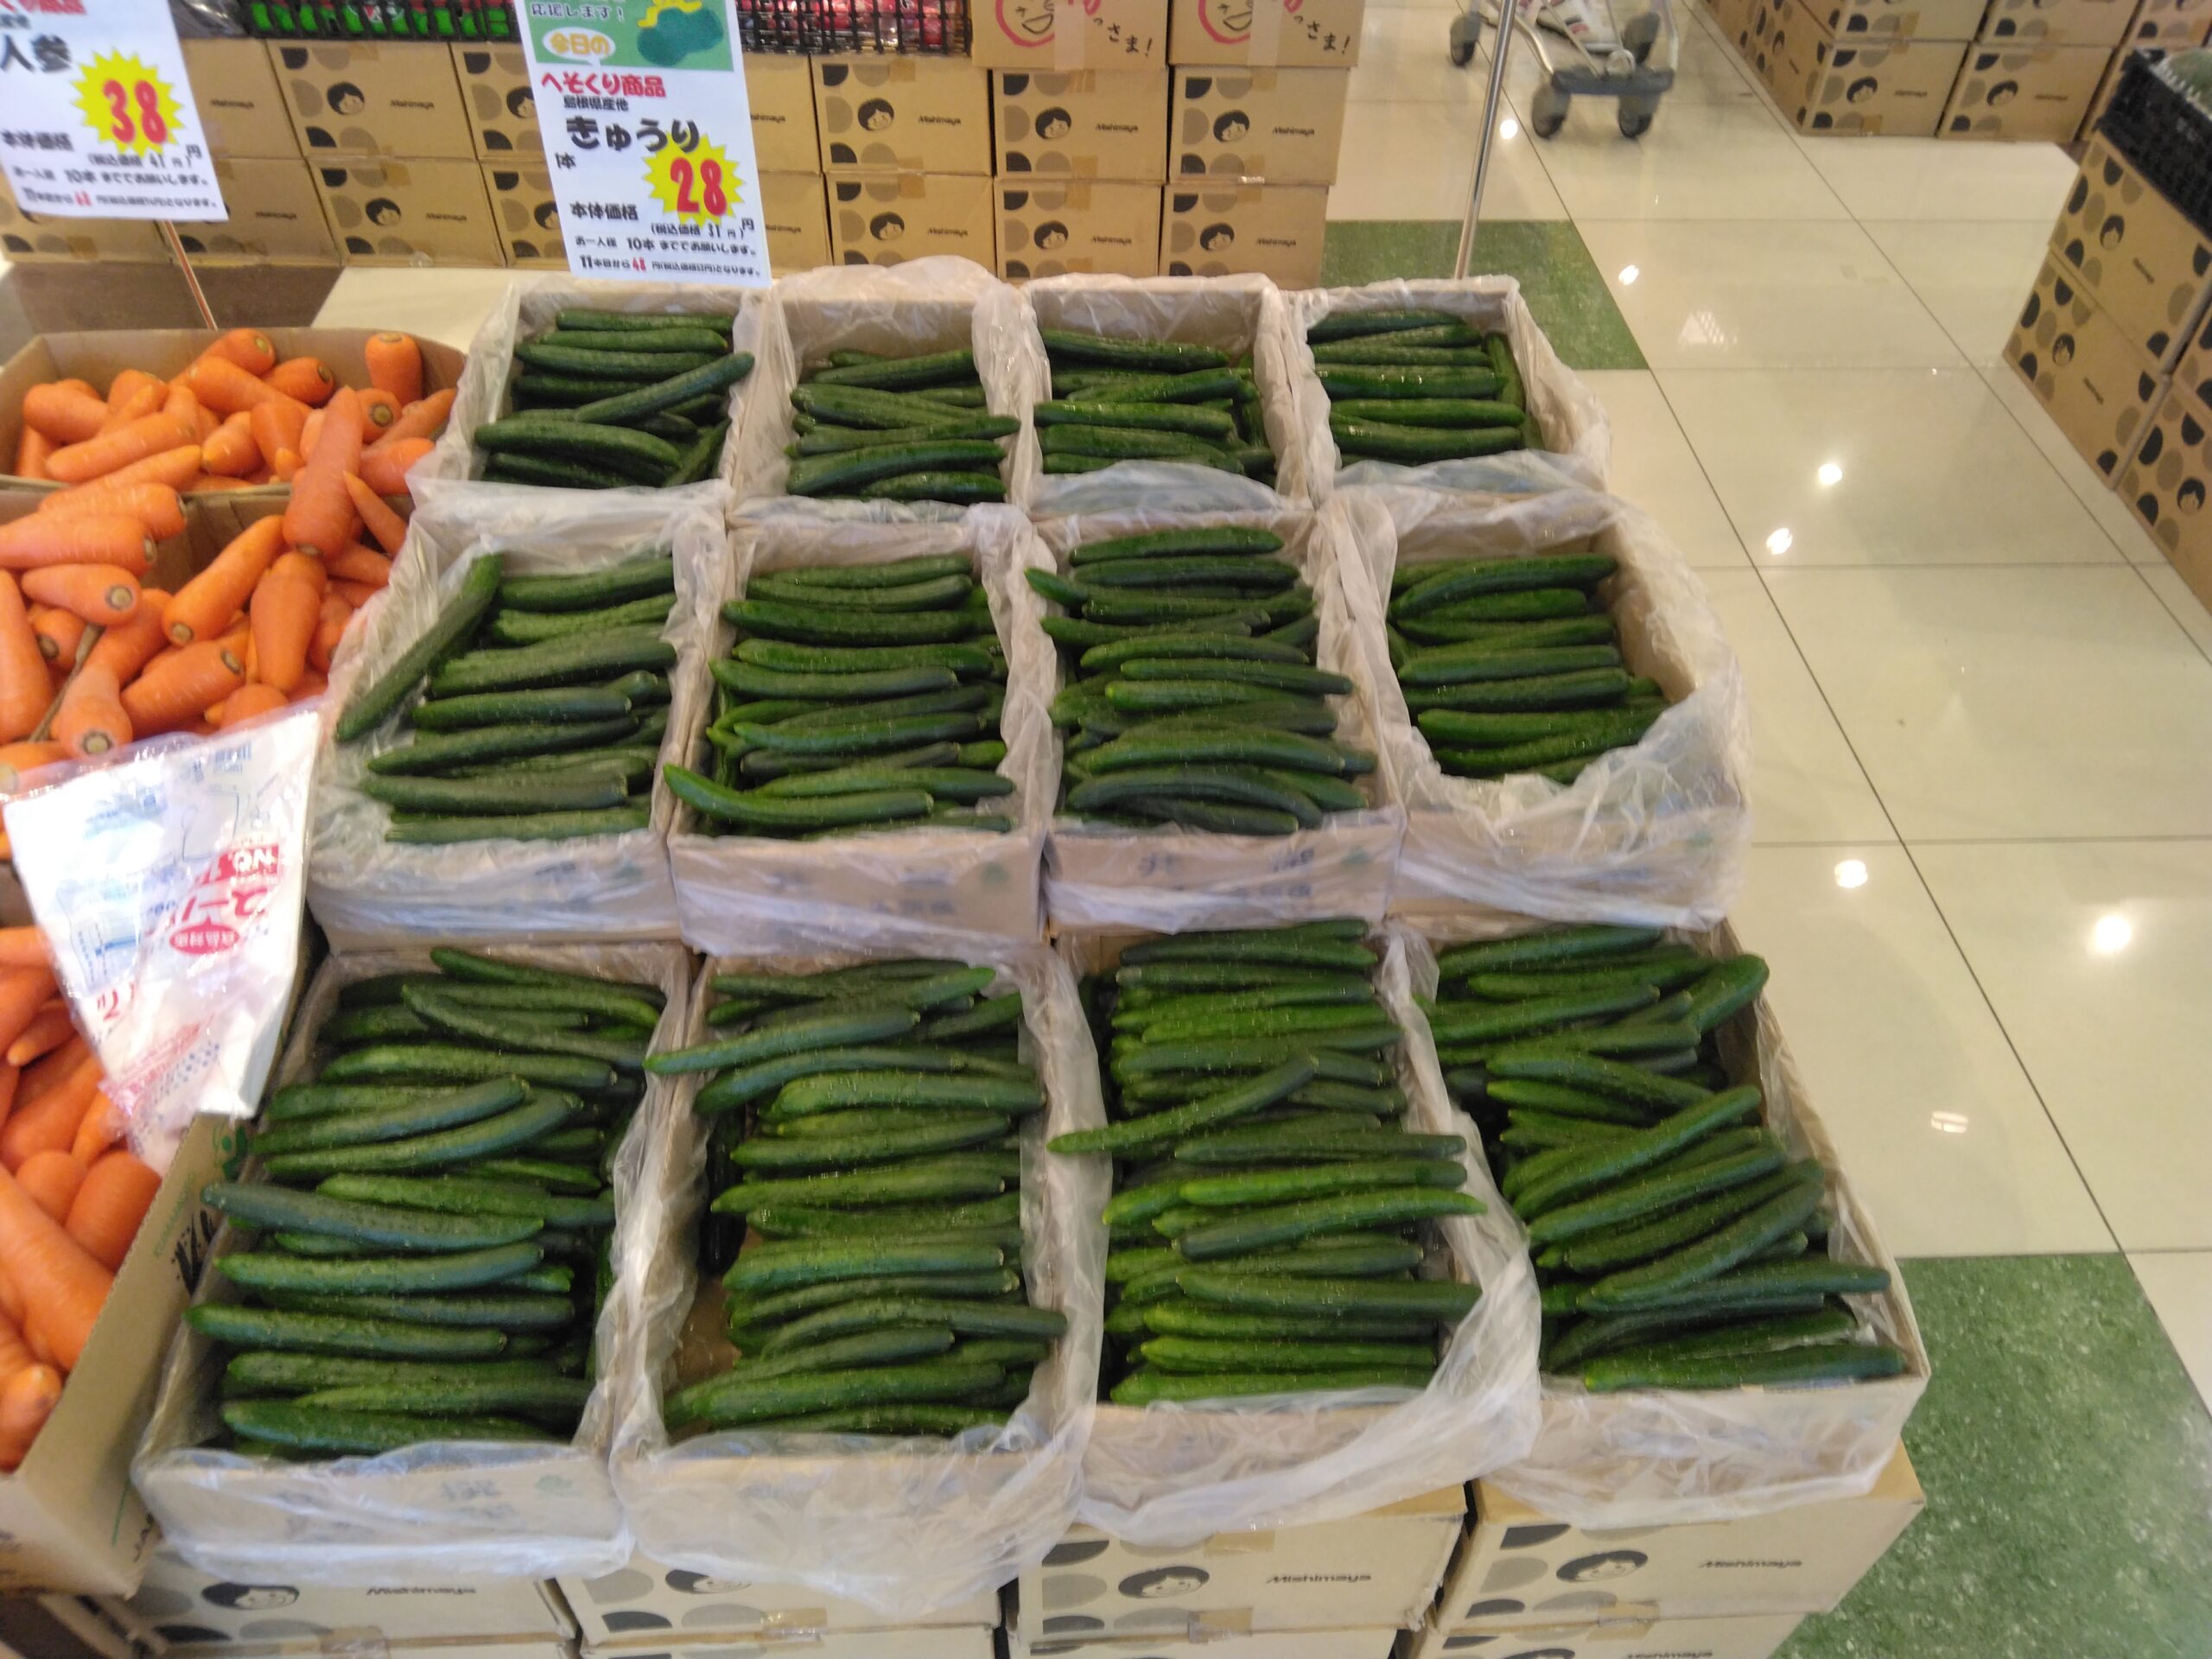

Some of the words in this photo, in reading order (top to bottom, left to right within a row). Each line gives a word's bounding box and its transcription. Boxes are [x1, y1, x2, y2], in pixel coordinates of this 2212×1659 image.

[0, 34, 72, 73] 人参
[550, 32, 610, 55] 今日の
[542, 72, 667, 98] へそくり商品
[103, 79, 169, 144] 38
[567, 116, 701, 153] きゅうり
[671, 158, 728, 216] 28
[570, 201, 639, 221] 本体価格
[1266, 1573, 1372, 1585] Mishimaya
